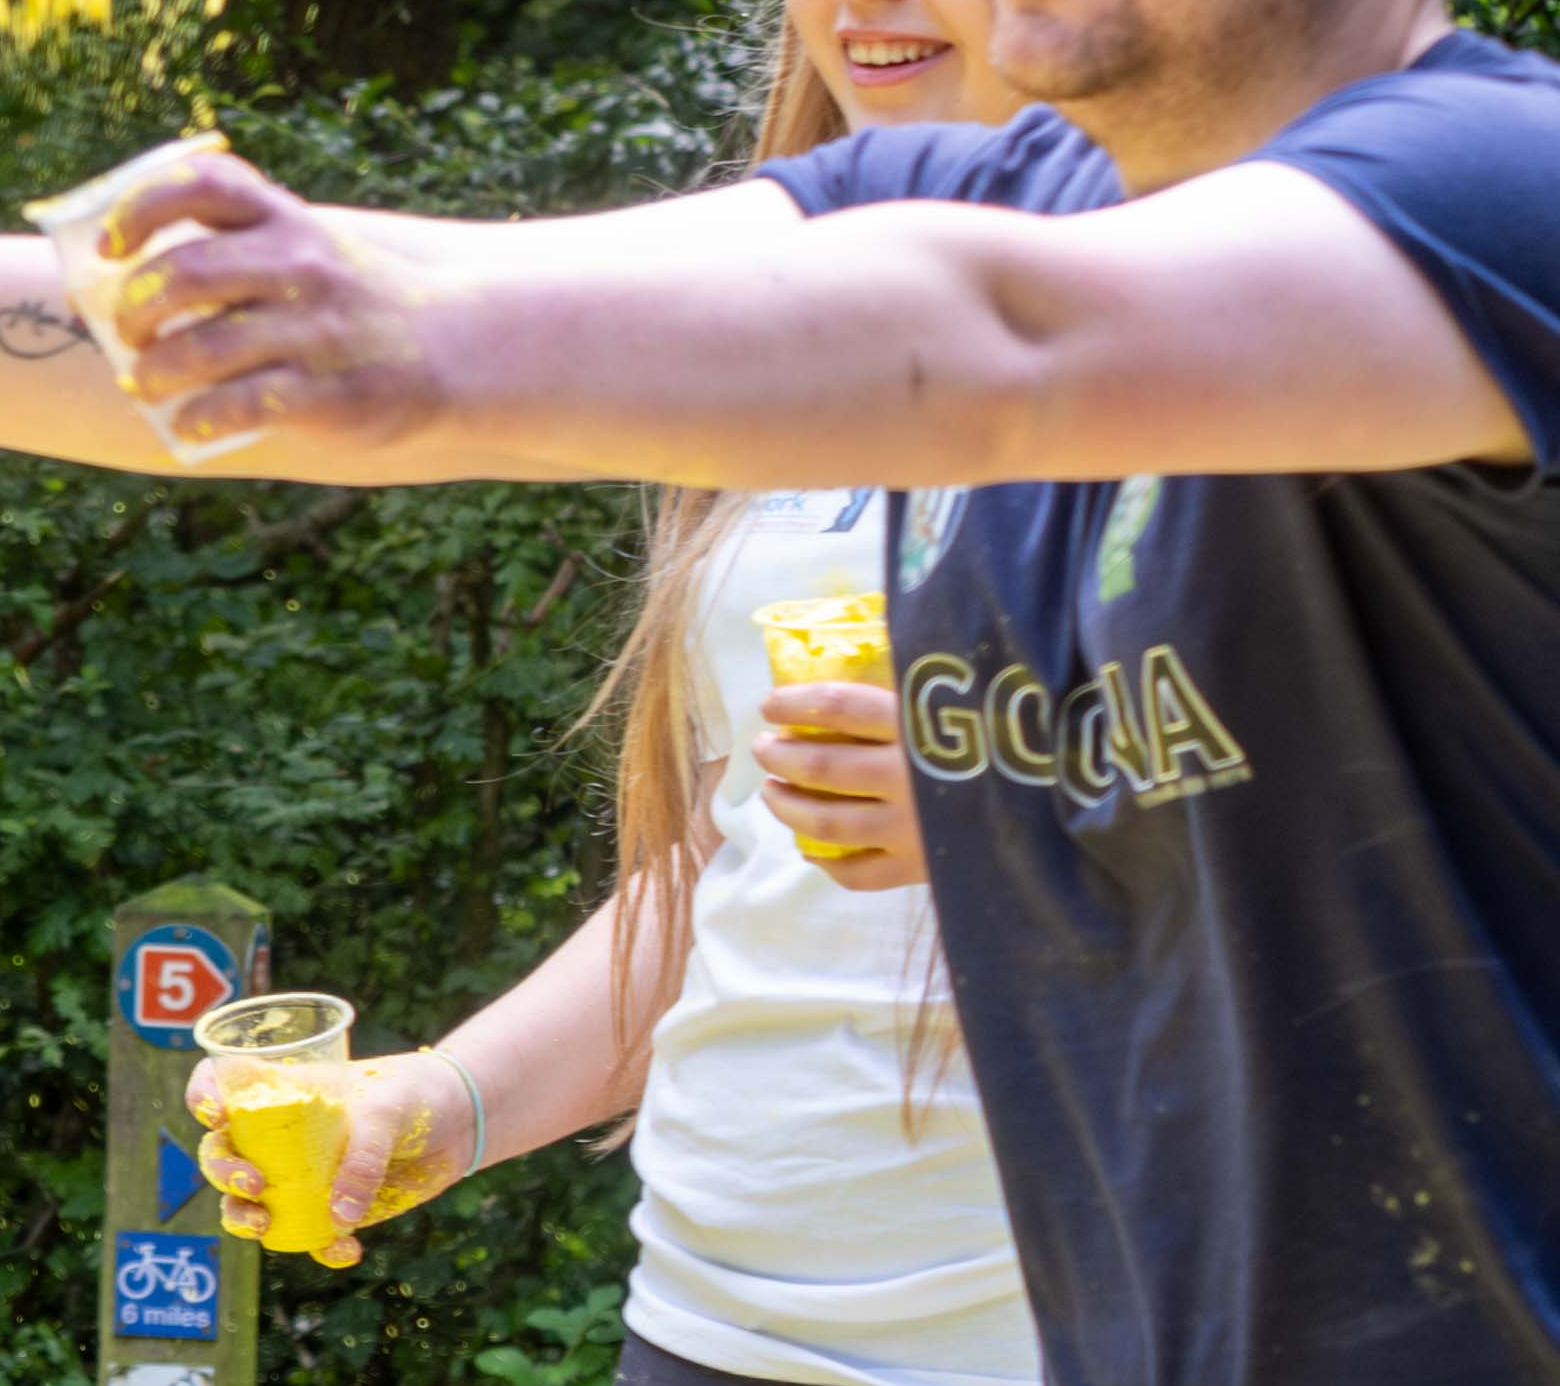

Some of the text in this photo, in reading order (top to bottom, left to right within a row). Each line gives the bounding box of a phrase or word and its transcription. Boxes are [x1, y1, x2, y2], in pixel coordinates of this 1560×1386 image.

[156, 959, 196, 1012] 5
[121, 1302, 211, 1328] 6 miles
